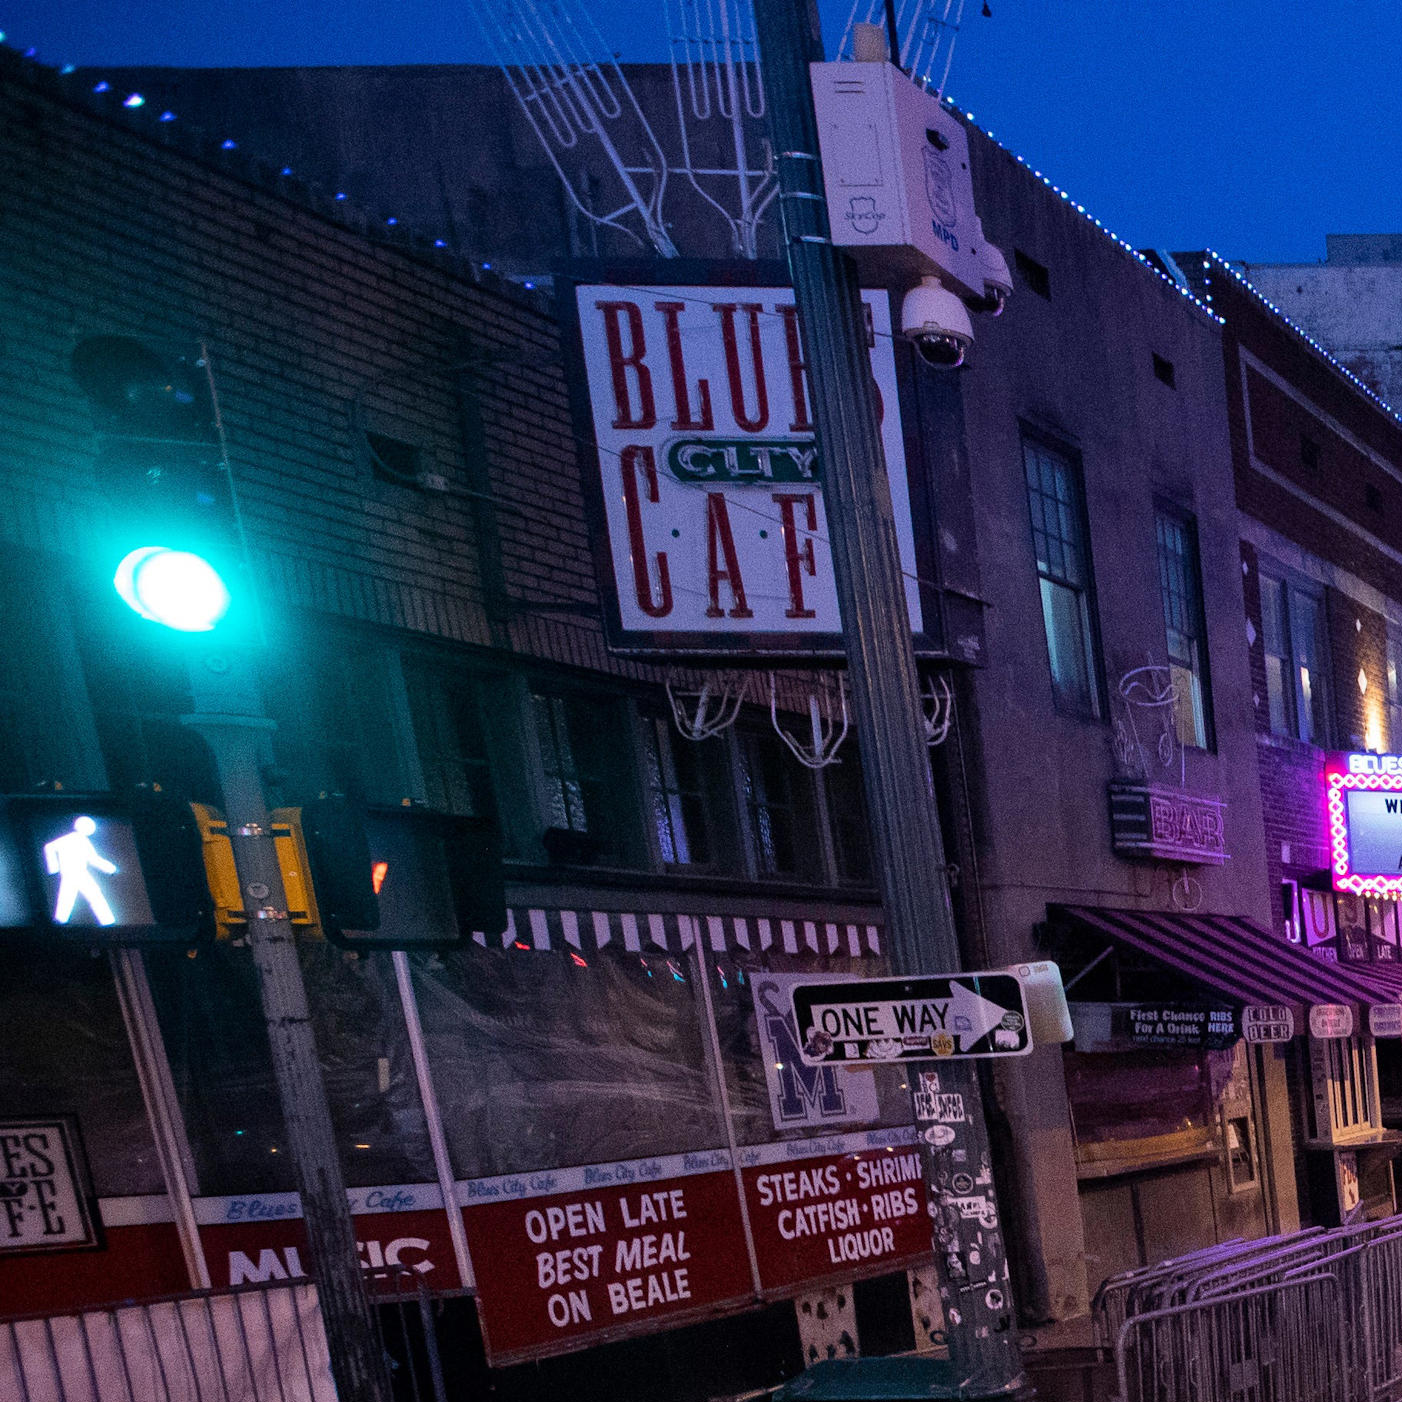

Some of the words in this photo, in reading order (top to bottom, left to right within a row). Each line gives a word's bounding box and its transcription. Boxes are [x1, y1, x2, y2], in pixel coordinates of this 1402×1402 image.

[932, 219, 959, 252] MPD
[595, 300, 884, 433] BLUE
[678, 445, 817, 481] CITY
[621, 445, 817, 619] CAF
[1151, 797, 1225, 852] BAR
[821, 1006, 884, 1040] ONE
[892, 1003, 949, 1035] WAY
[1208, 1022, 1234, 1033] HERE
[1210, 1011, 1233, 1022] RIBS
[1249, 1023, 1290, 1040] BEER
[757, 1169, 840, 1206] STEAKS
[525, 1200, 607, 1244] OPEN
[619, 1190, 688, 1229] LATE
[777, 1198, 860, 1240] CATFISH
[874, 1188, 919, 1221] RIBS
[228, 1237, 435, 1286] MUIC
[536, 1245, 604, 1289] BEST
[614, 1231, 691, 1274] MEAL
[828, 1227, 896, 1264] LIQUOR
[547, 1290, 593, 1328] ON
[610, 1269, 692, 1316] BEALE
